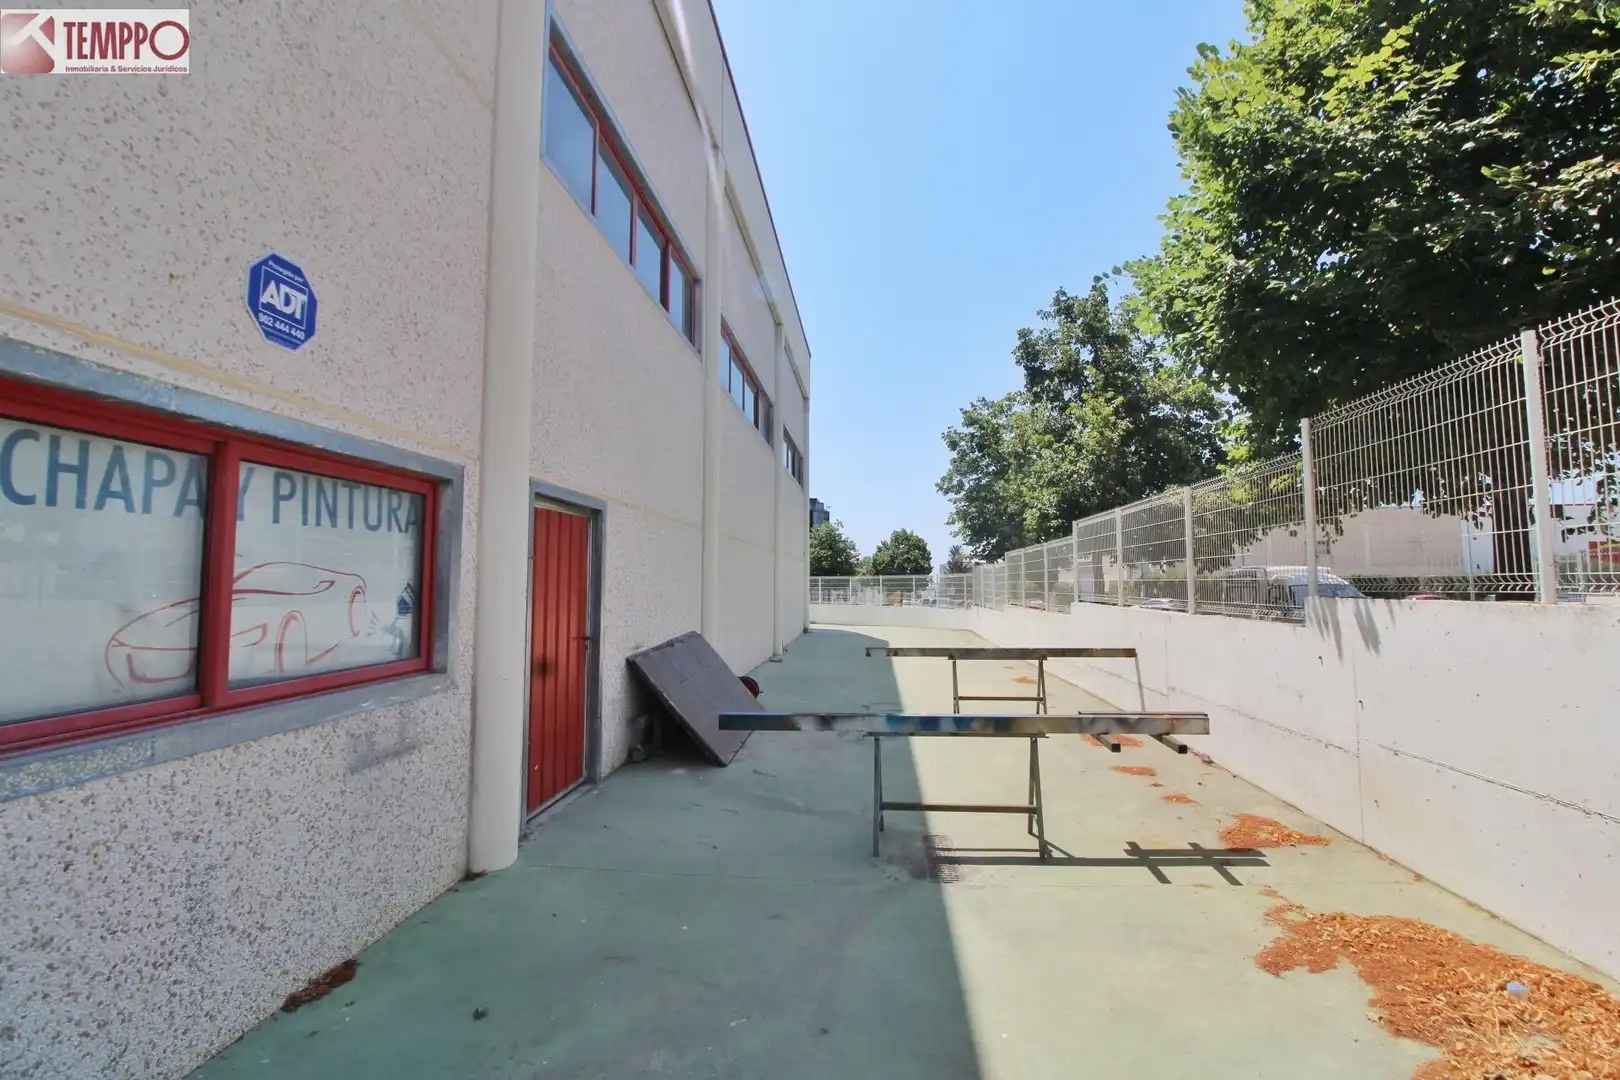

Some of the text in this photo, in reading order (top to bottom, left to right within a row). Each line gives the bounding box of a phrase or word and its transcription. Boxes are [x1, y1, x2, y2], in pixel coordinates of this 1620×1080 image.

[260, 280, 308, 319] ADT
[0, 428, 206, 519] CHAPA
[271, 470, 421, 534] PINTURA
